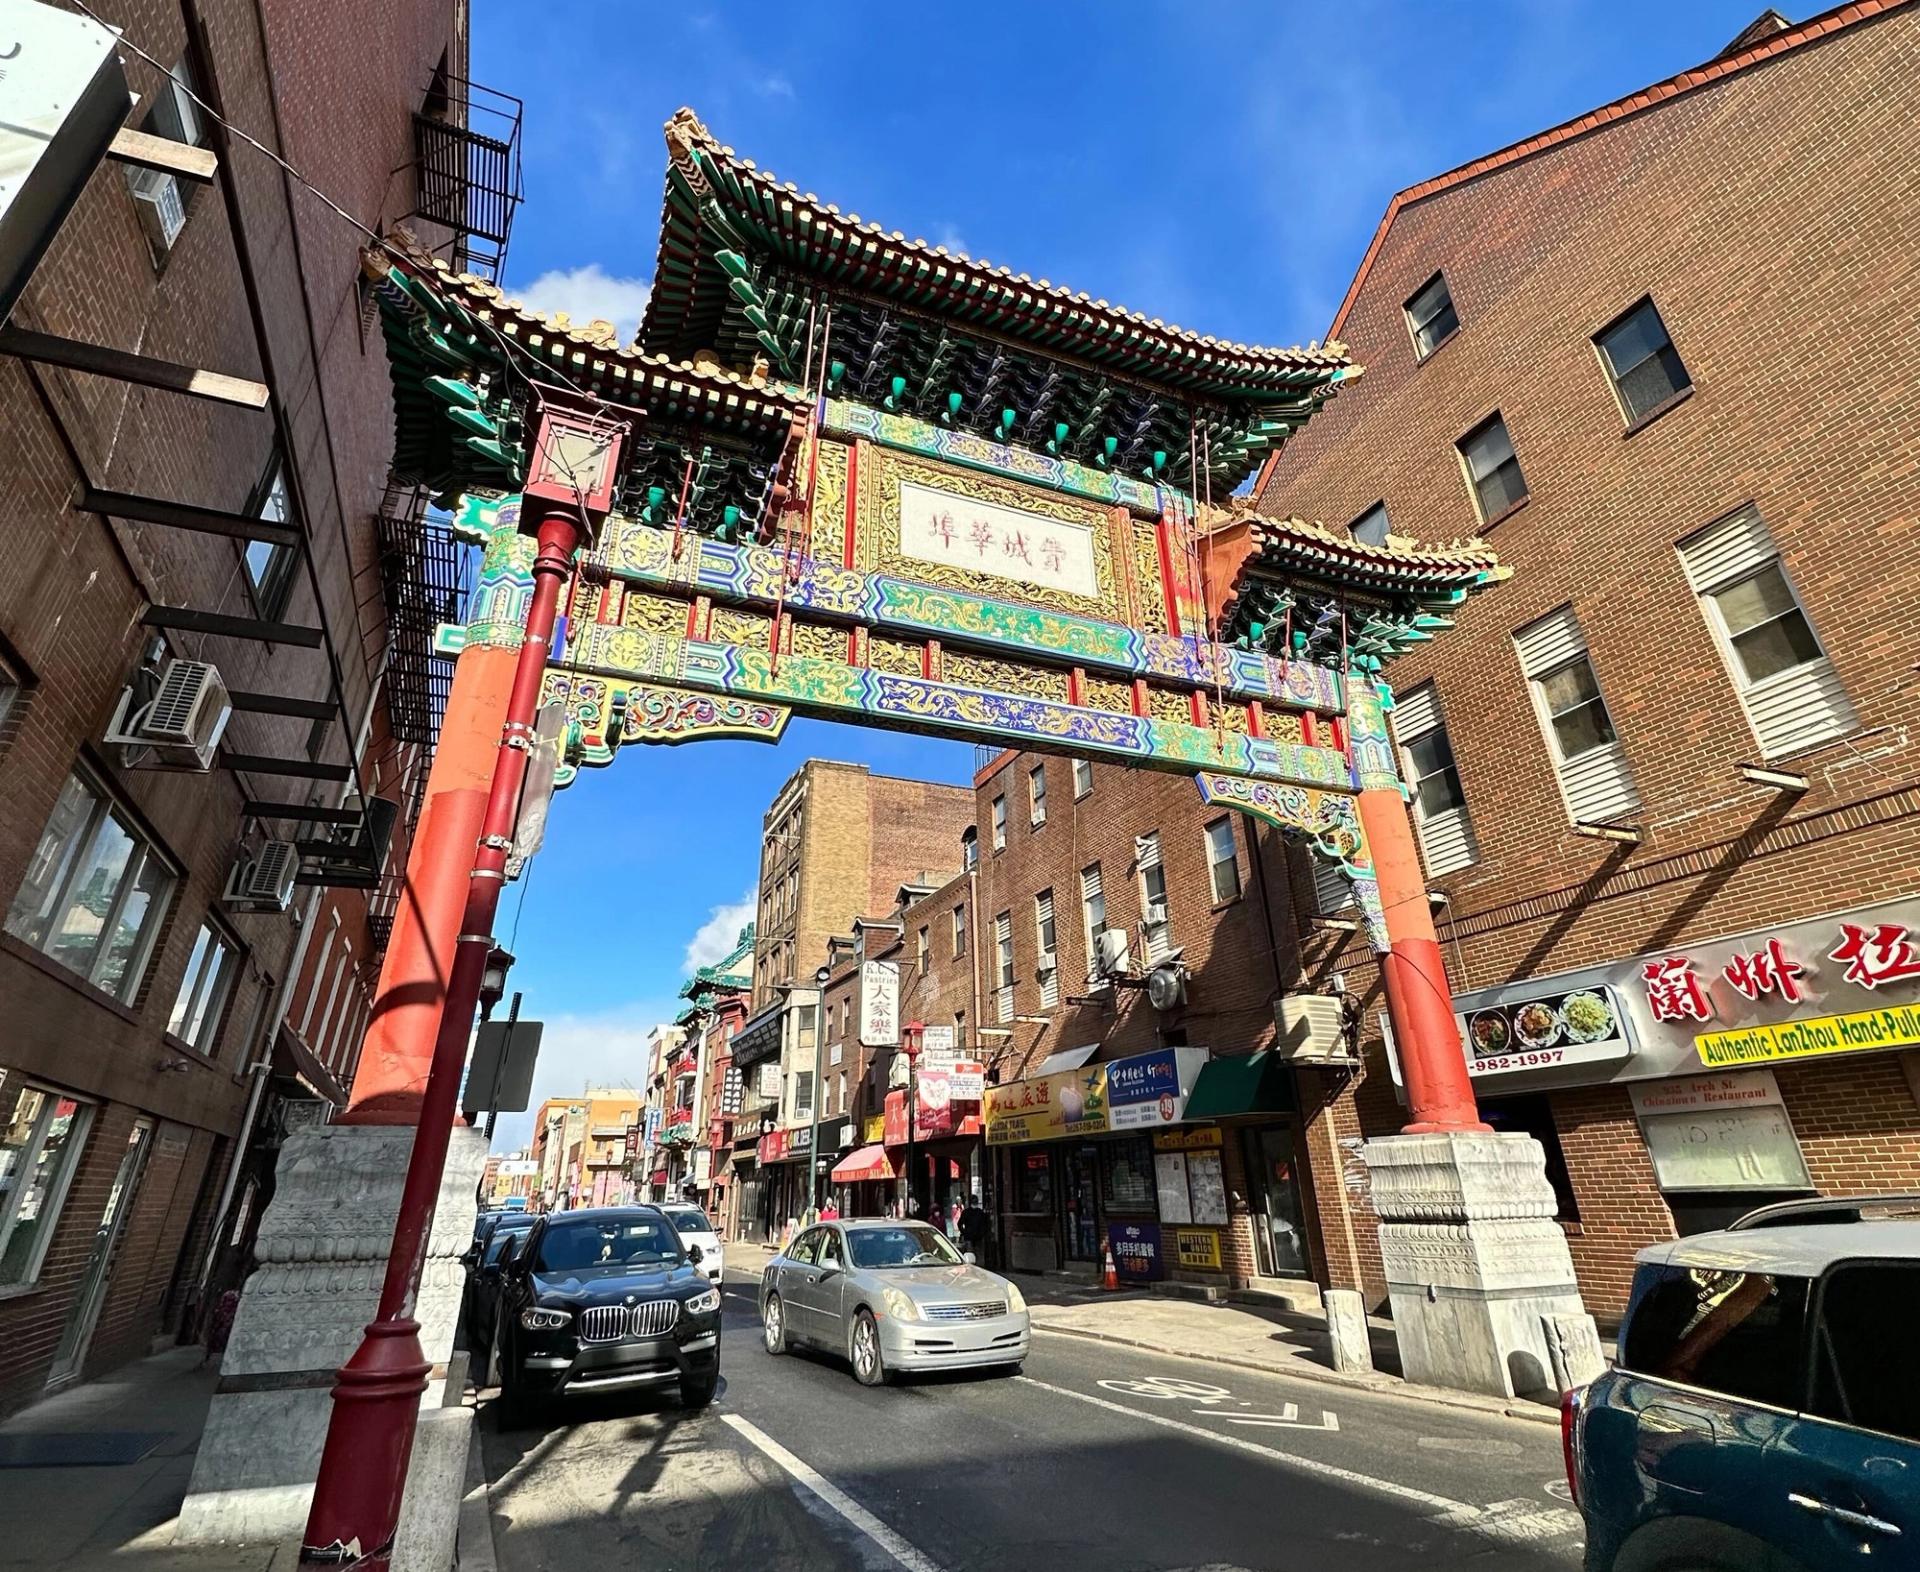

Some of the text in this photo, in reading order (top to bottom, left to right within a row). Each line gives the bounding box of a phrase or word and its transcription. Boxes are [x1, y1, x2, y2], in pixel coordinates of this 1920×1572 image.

[864, 975, 898, 985] Pastries
[1703, 1032, 1772, 1063] Authentic
[1770, 1023, 1838, 1054] LanZhou
[1721, 1079, 1736, 1090] St.
[1642, 1088, 1767, 1107] Chinatown Restaurant
[1181, 1235, 1212, 1244] WESTERN
[1190, 1243, 1213, 1253] UNION
